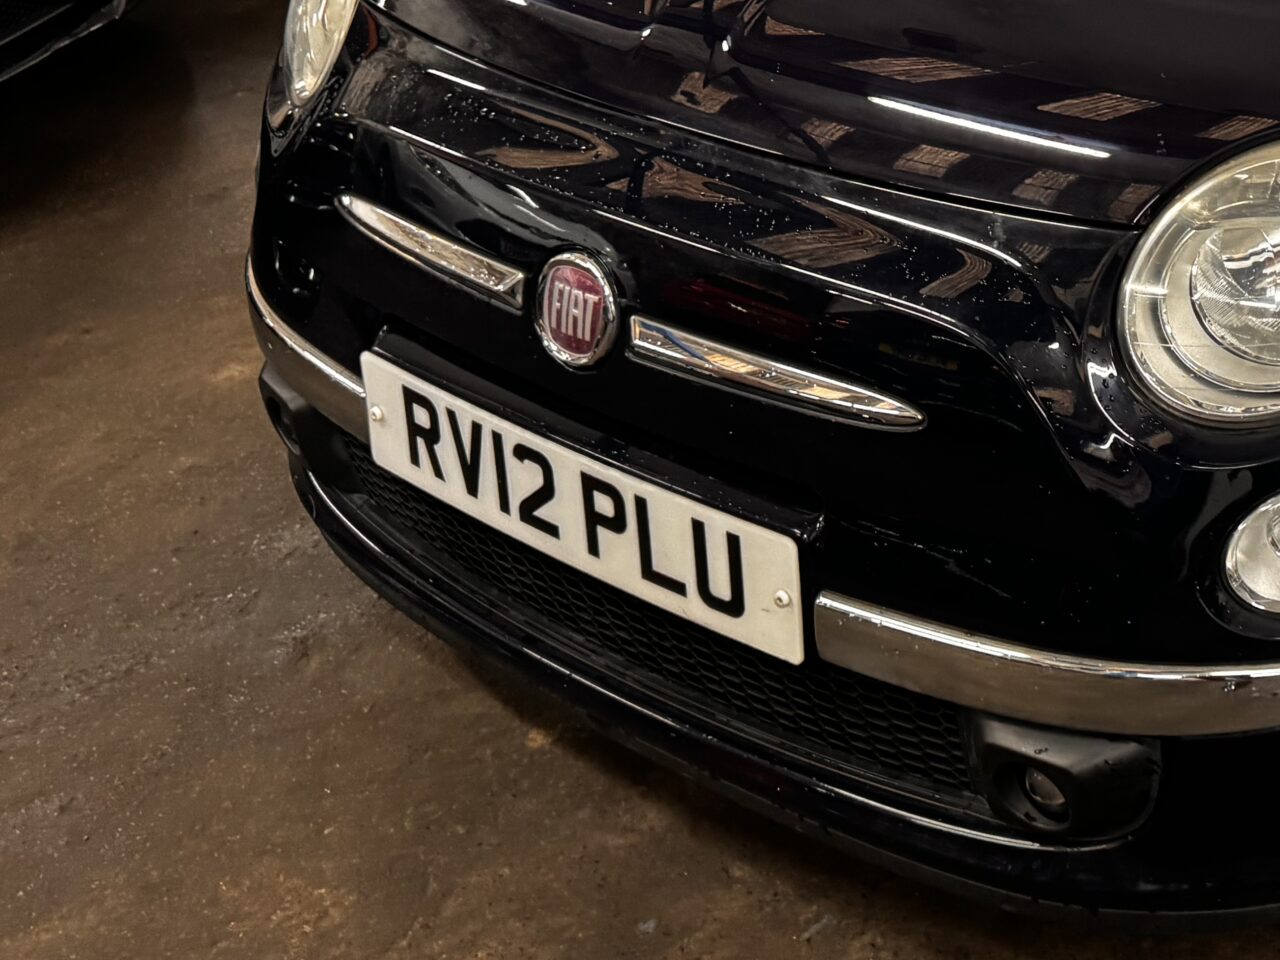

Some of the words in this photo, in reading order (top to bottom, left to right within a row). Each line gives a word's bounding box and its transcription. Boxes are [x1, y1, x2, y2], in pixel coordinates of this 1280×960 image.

[550, 281, 602, 342] FIAT
[402, 385, 561, 540] RV12
[580, 470, 746, 619] PLU
